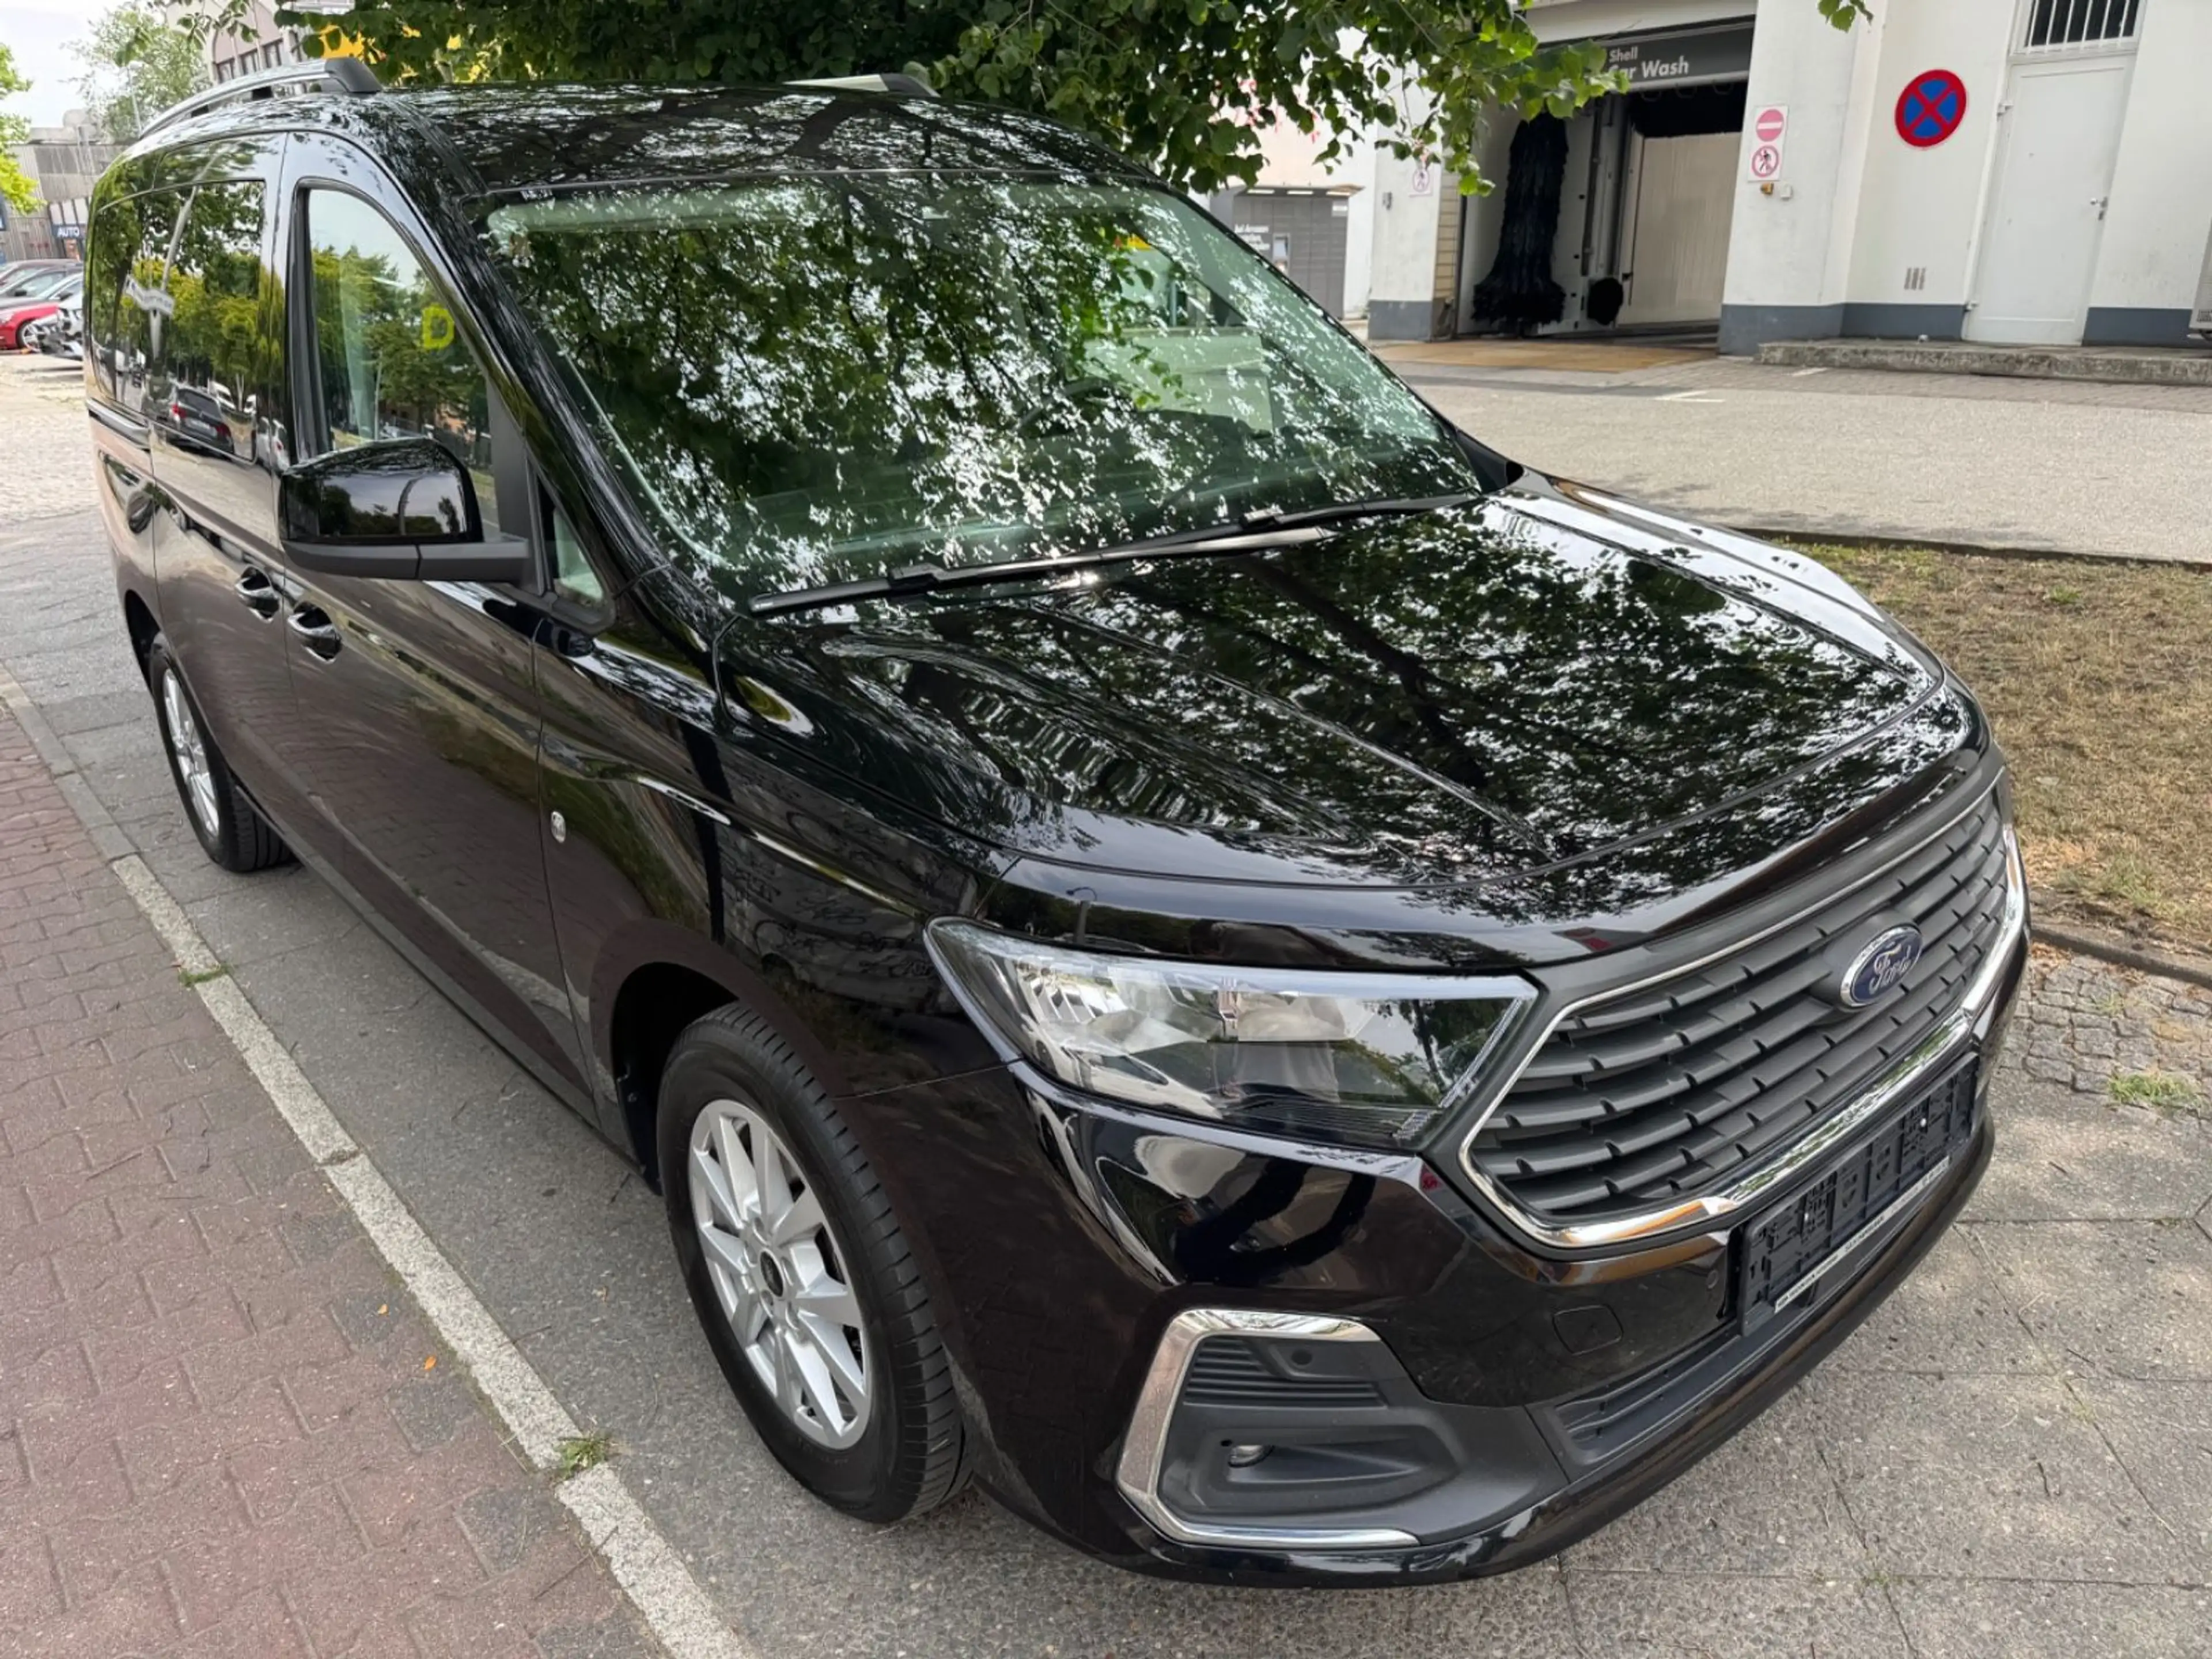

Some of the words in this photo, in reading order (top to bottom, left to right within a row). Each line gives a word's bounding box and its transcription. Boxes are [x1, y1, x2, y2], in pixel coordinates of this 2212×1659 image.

[1609, 46, 1638, 63] Shell
[1642, 55, 1689, 78] Wash
[57, 226, 80, 237] AUTO
[1869, 943, 1911, 995] Ford
